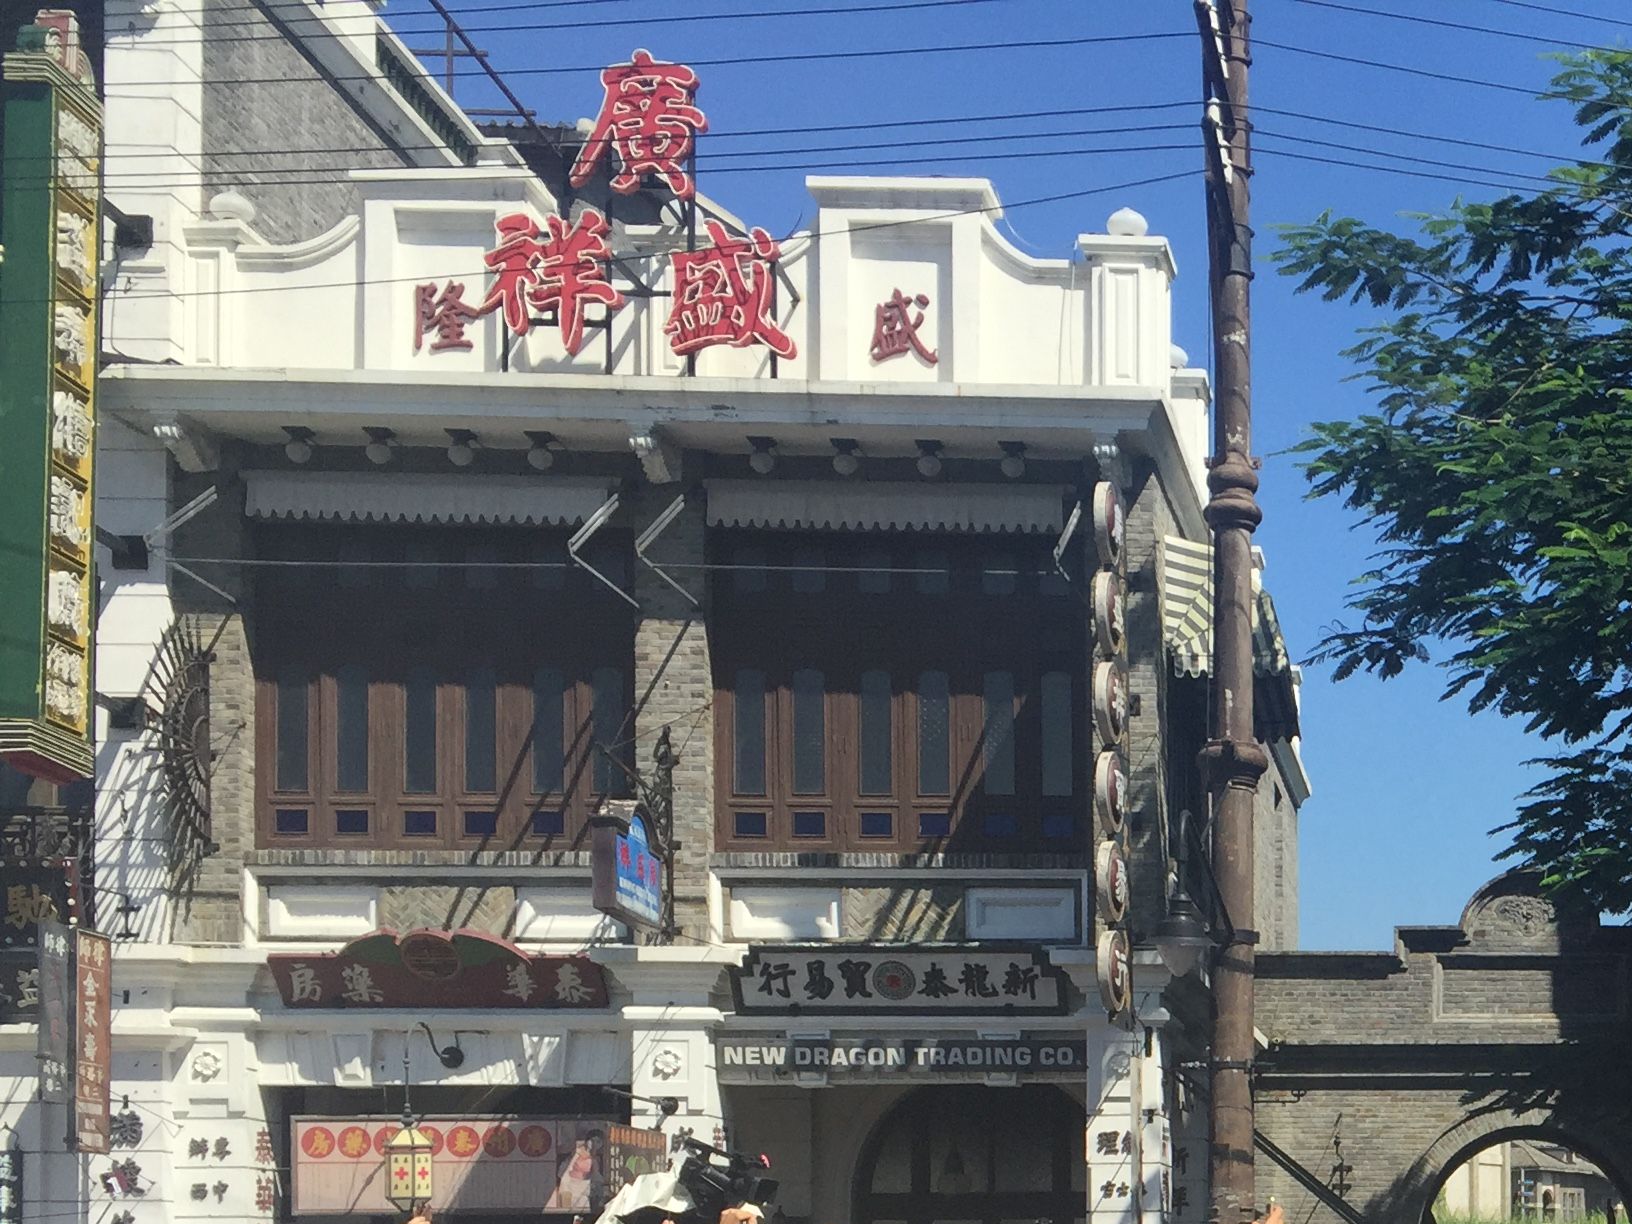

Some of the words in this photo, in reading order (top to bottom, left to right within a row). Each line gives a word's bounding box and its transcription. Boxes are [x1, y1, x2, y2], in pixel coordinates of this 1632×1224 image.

[724, 1046, 786, 1066] NEW
[794, 1046, 906, 1067] DRAGON
[915, 1046, 1032, 1067] TRADING
[1039, 1046, 1082, 1067] CO.
